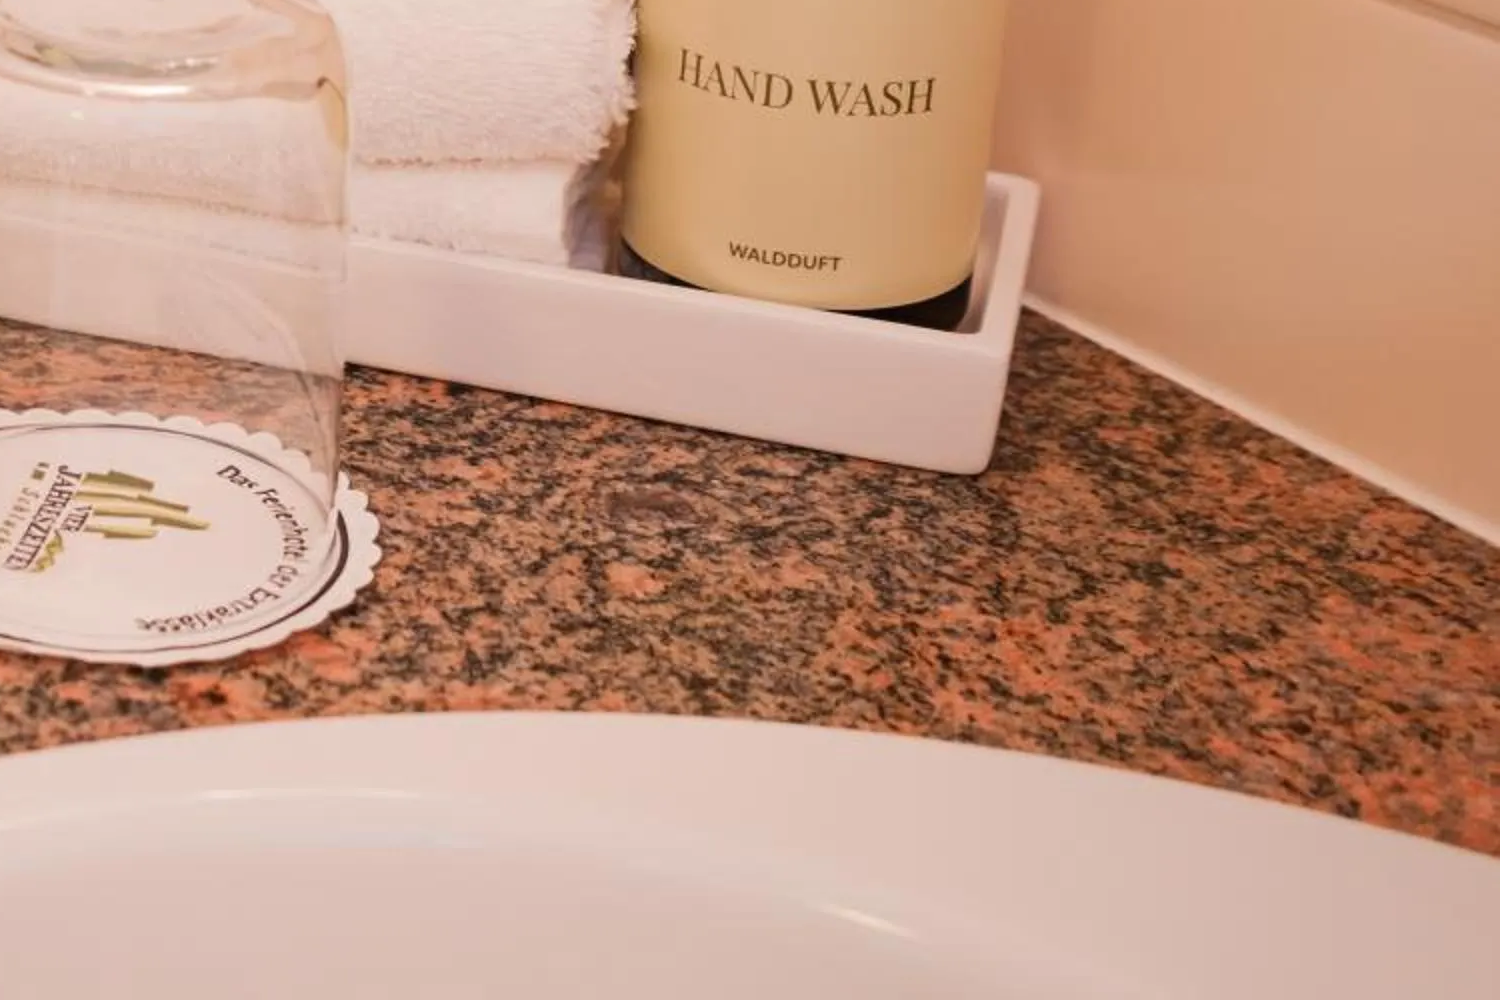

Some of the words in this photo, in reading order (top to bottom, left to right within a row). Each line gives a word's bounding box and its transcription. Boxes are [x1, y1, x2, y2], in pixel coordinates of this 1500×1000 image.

[678, 48, 794, 111] HAND
[806, 76, 937, 118] WASH
[728, 241, 843, 272] WALDDUFT
[216, 464, 259, 490] Das
